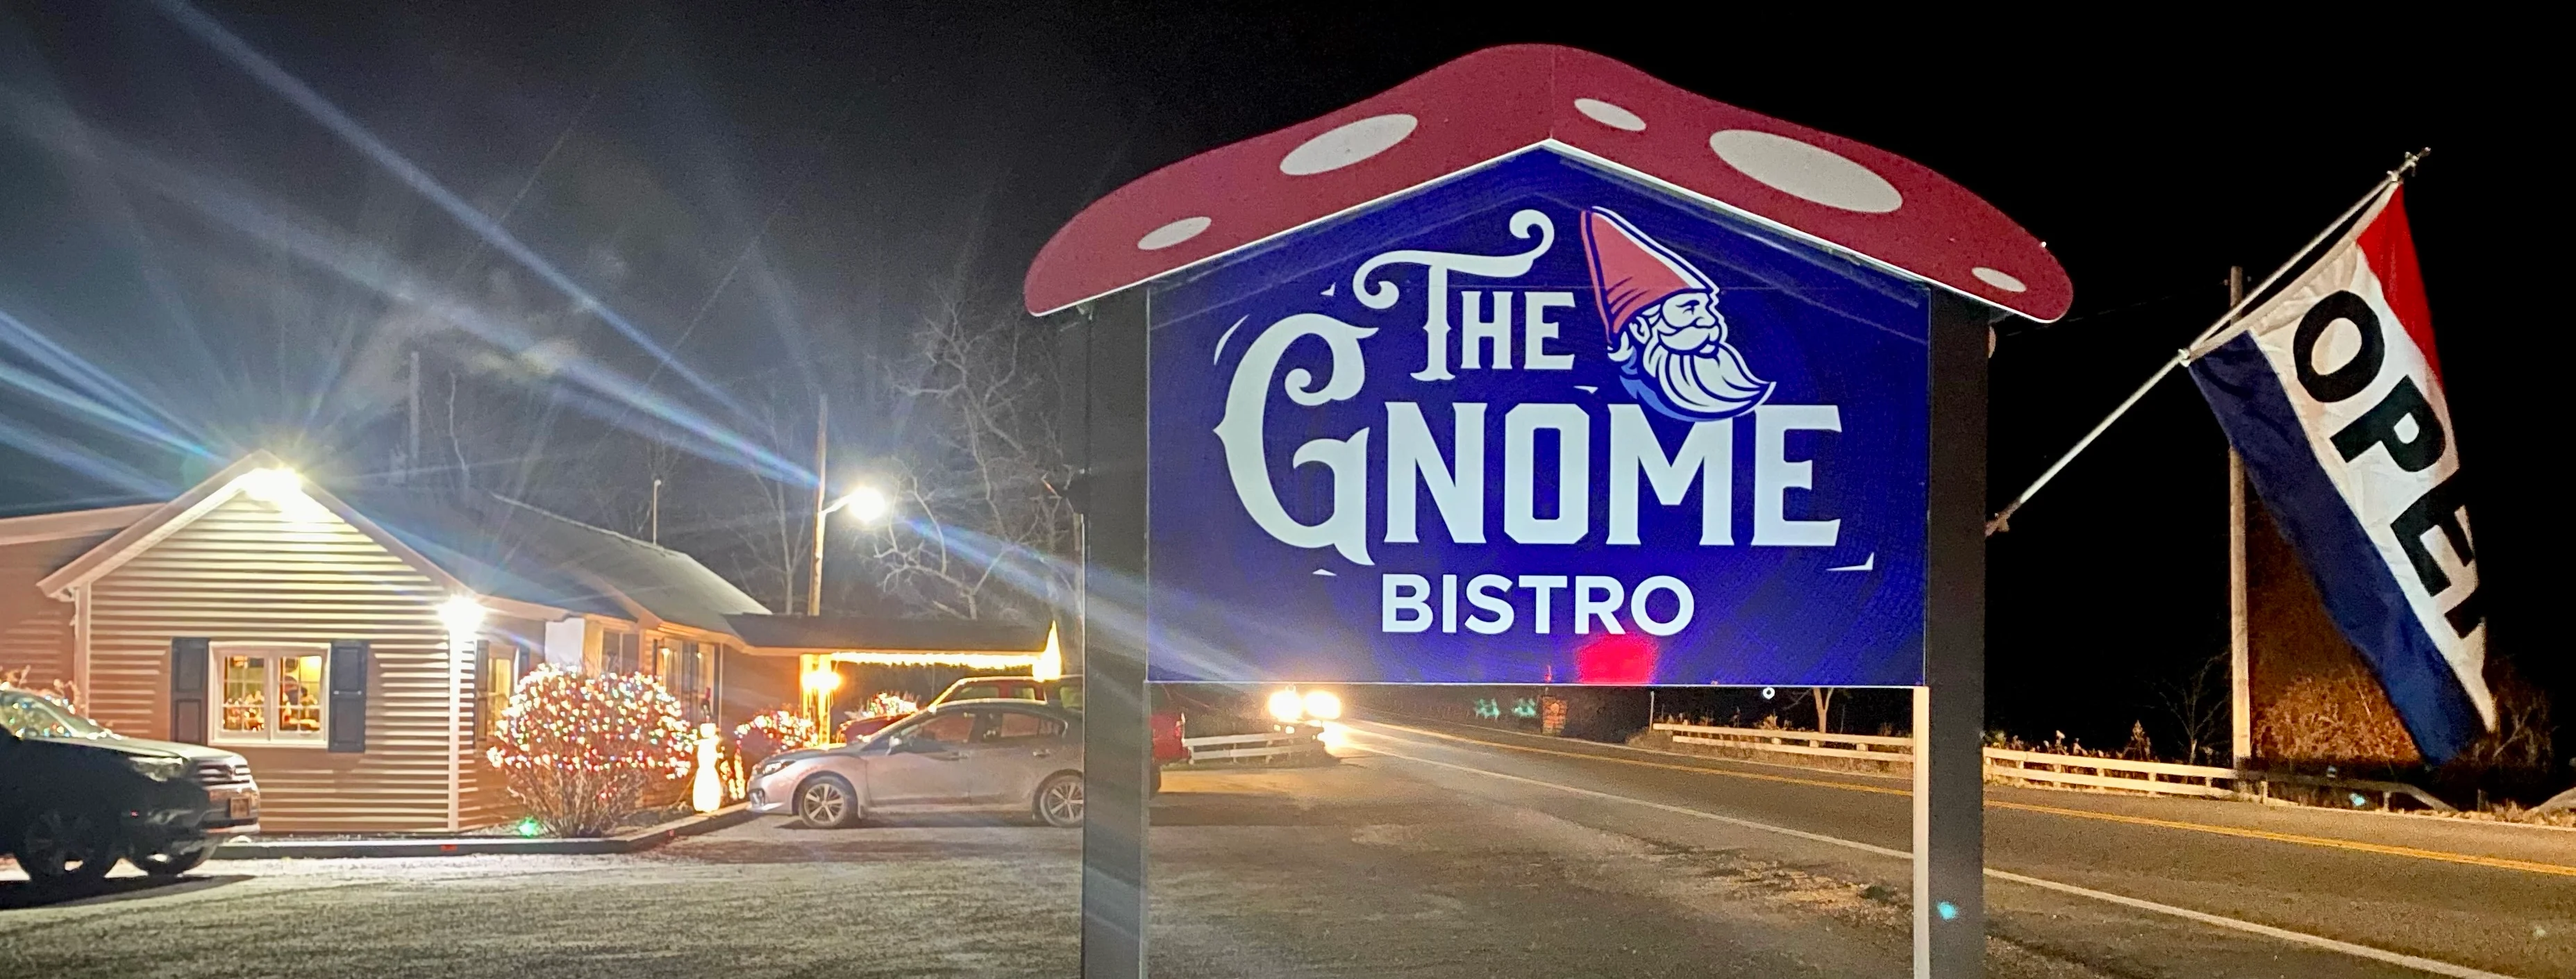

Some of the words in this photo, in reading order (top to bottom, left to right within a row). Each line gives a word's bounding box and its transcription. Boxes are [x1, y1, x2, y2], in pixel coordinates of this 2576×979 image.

[1212, 312, 1842, 567] GNOME
[2293, 290, 2486, 639] OPE
[1382, 574, 1695, 637] BISTRO
